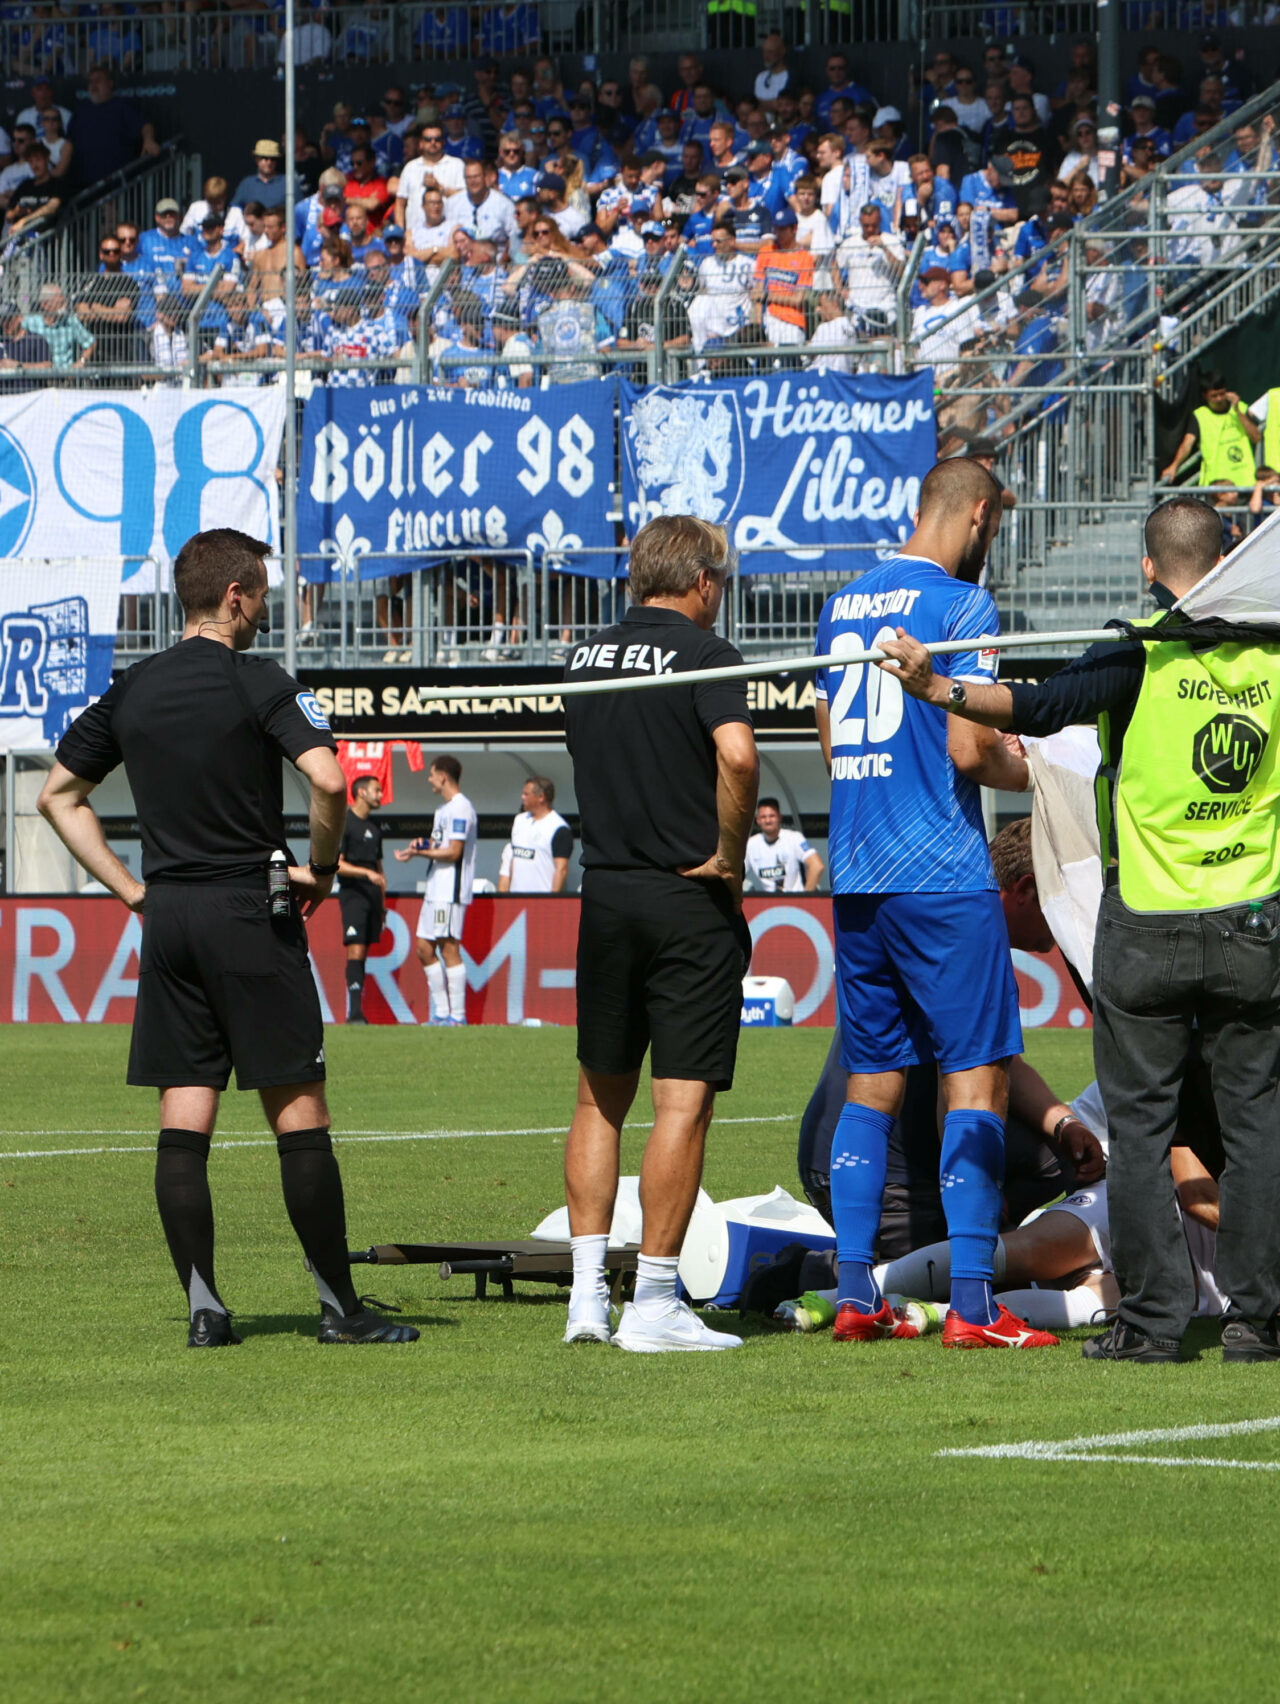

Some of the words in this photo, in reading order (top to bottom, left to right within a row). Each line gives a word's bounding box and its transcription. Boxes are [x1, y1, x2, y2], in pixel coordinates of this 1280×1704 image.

[464, 386, 531, 413] Tradition
[744, 379, 932, 440] Häzemer
[310, 417, 494, 503] Böller
[516, 414, 595, 498] 98
[735, 435, 922, 561] Lilien
[570, 644, 620, 671] DIE
[621, 644, 679, 676] ELV.
[316, 686, 375, 716] SER
[829, 625, 904, 748] 20
[1184, 795, 1253, 821] SERVICE
[1201, 842, 1246, 866] 200
